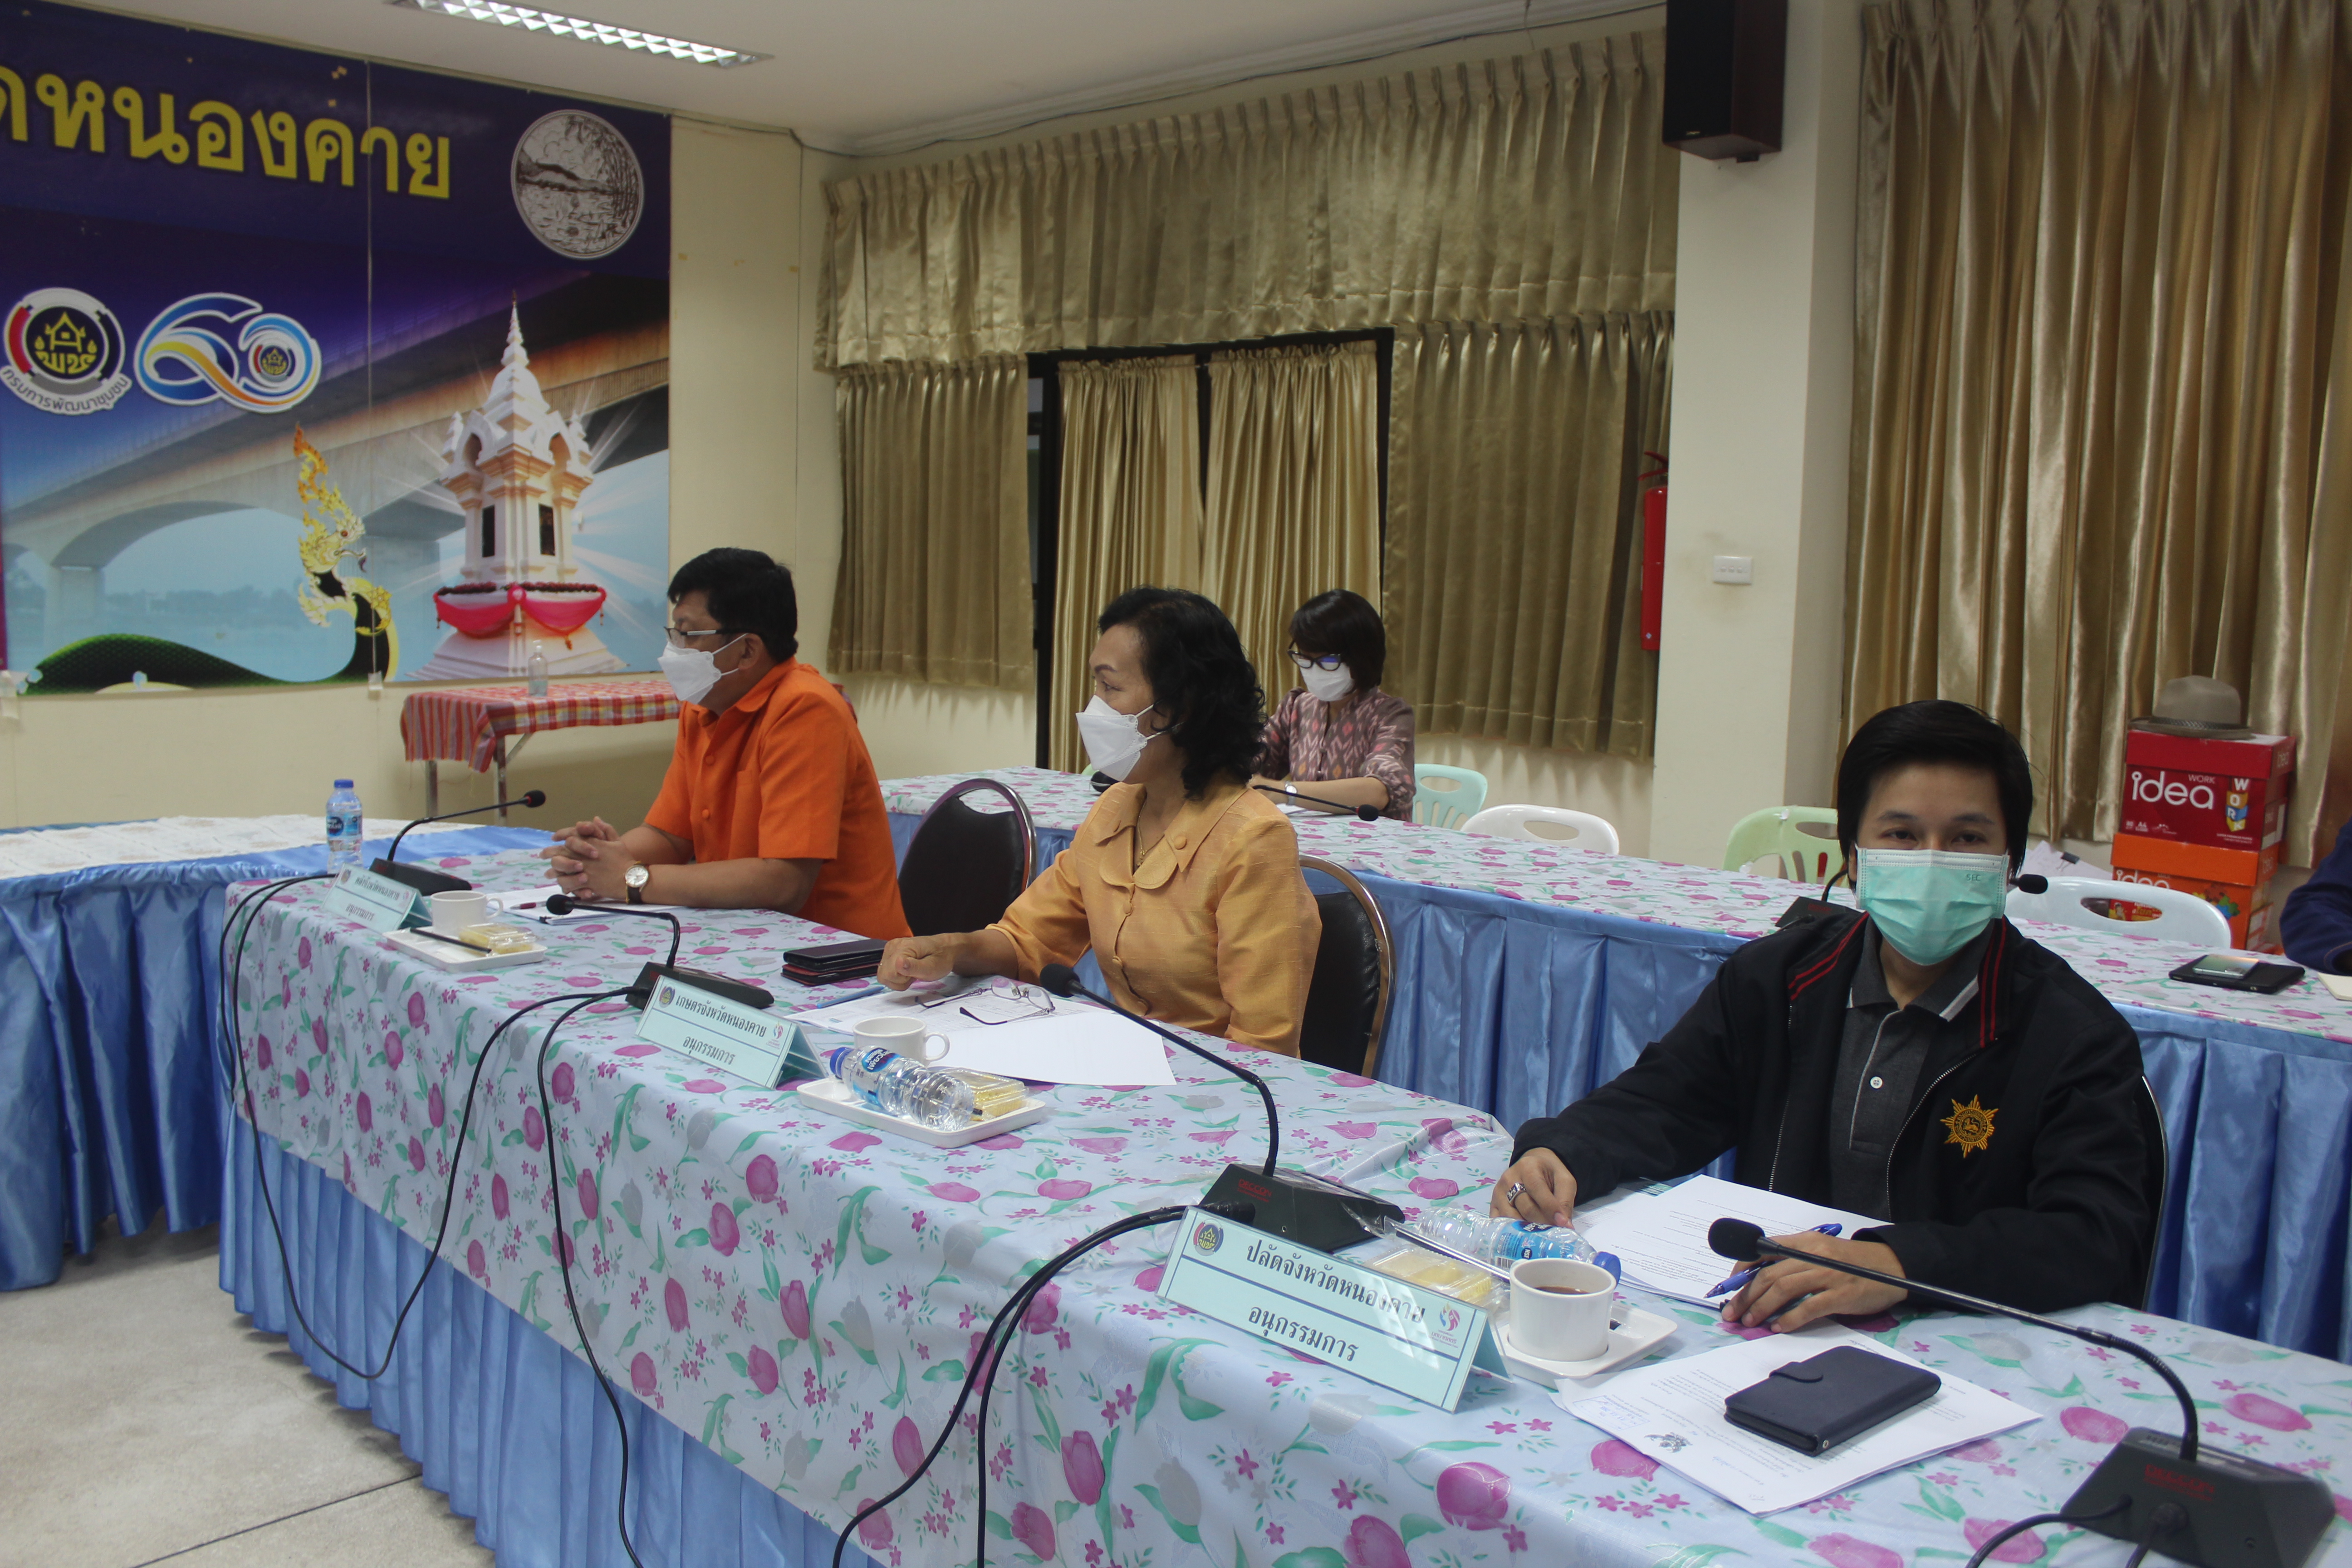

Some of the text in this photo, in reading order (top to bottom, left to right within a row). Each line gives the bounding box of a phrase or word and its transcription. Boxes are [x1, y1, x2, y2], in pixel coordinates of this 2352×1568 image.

[3, 369, 128, 411] กรมการพัฒนาชุมชน
[2132, 771, 2213, 809] idea
[2188, 774, 2215, 784] WORK
[675, 995, 767, 1038] เกษตรจังหวัดหนองคาย
[682, 1036, 736, 1065] อนุกรรมการ
[1238, 1179, 1272, 1197] DECCON
[1246, 1240, 1426, 1323] ปลัดจังหวัดหนองคาย
[1248, 1306, 1359, 1362] อนุกรรมการ
[2145, 1464, 2216, 1494] DECCON
